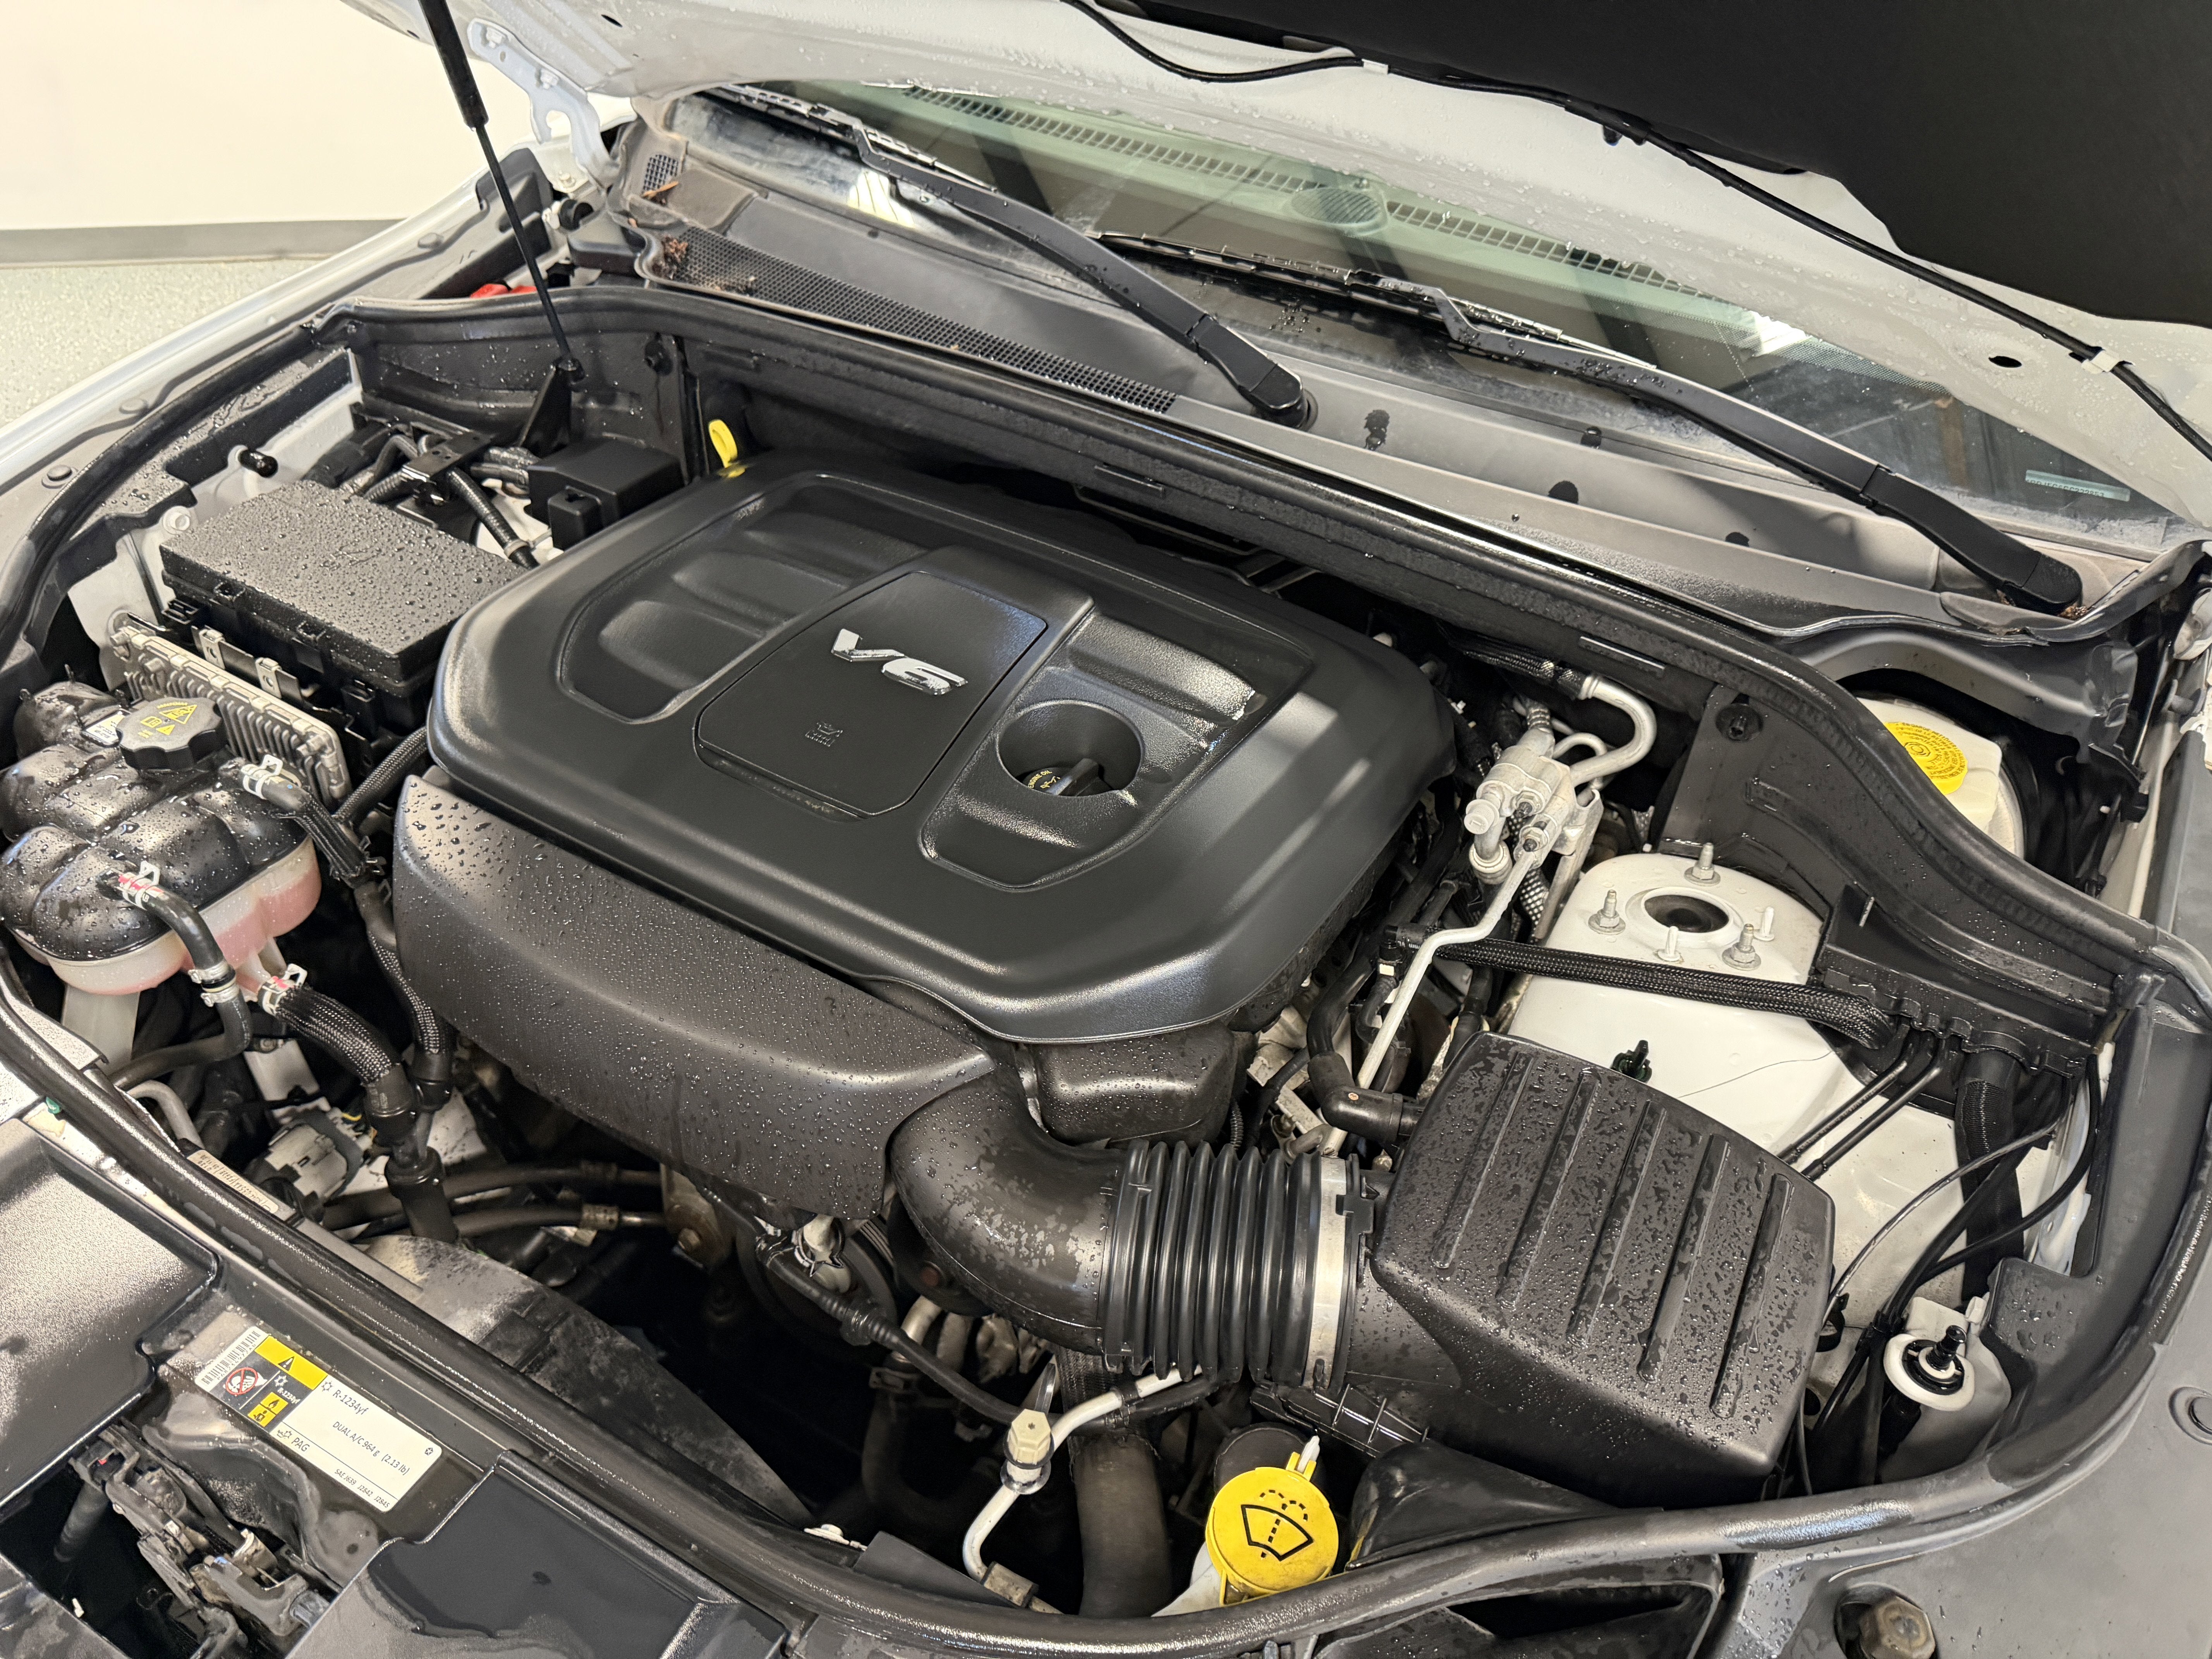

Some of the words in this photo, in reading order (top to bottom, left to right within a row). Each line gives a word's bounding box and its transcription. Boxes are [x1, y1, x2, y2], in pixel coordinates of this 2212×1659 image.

[831, 628, 968, 696] V6
[1028, 773, 1042, 788] ENGINE
[333, 1389, 369, 1415] R-1234yf
[291, 1437, 310, 1452] PAG
[333, 1421, 351, 1436] DUAL
[349, 1433, 364, 1444] A/C
[362, 1441, 376, 1452] 964
[381, 1454, 400, 1468] (2.13
[398, 1464, 410, 1476] lb)
[334, 1469, 345, 1478] SAE
[343, 1475, 357, 1485] J639
[357, 1485, 373, 1497] J2842
[374, 1496, 390, 1508] J2845
